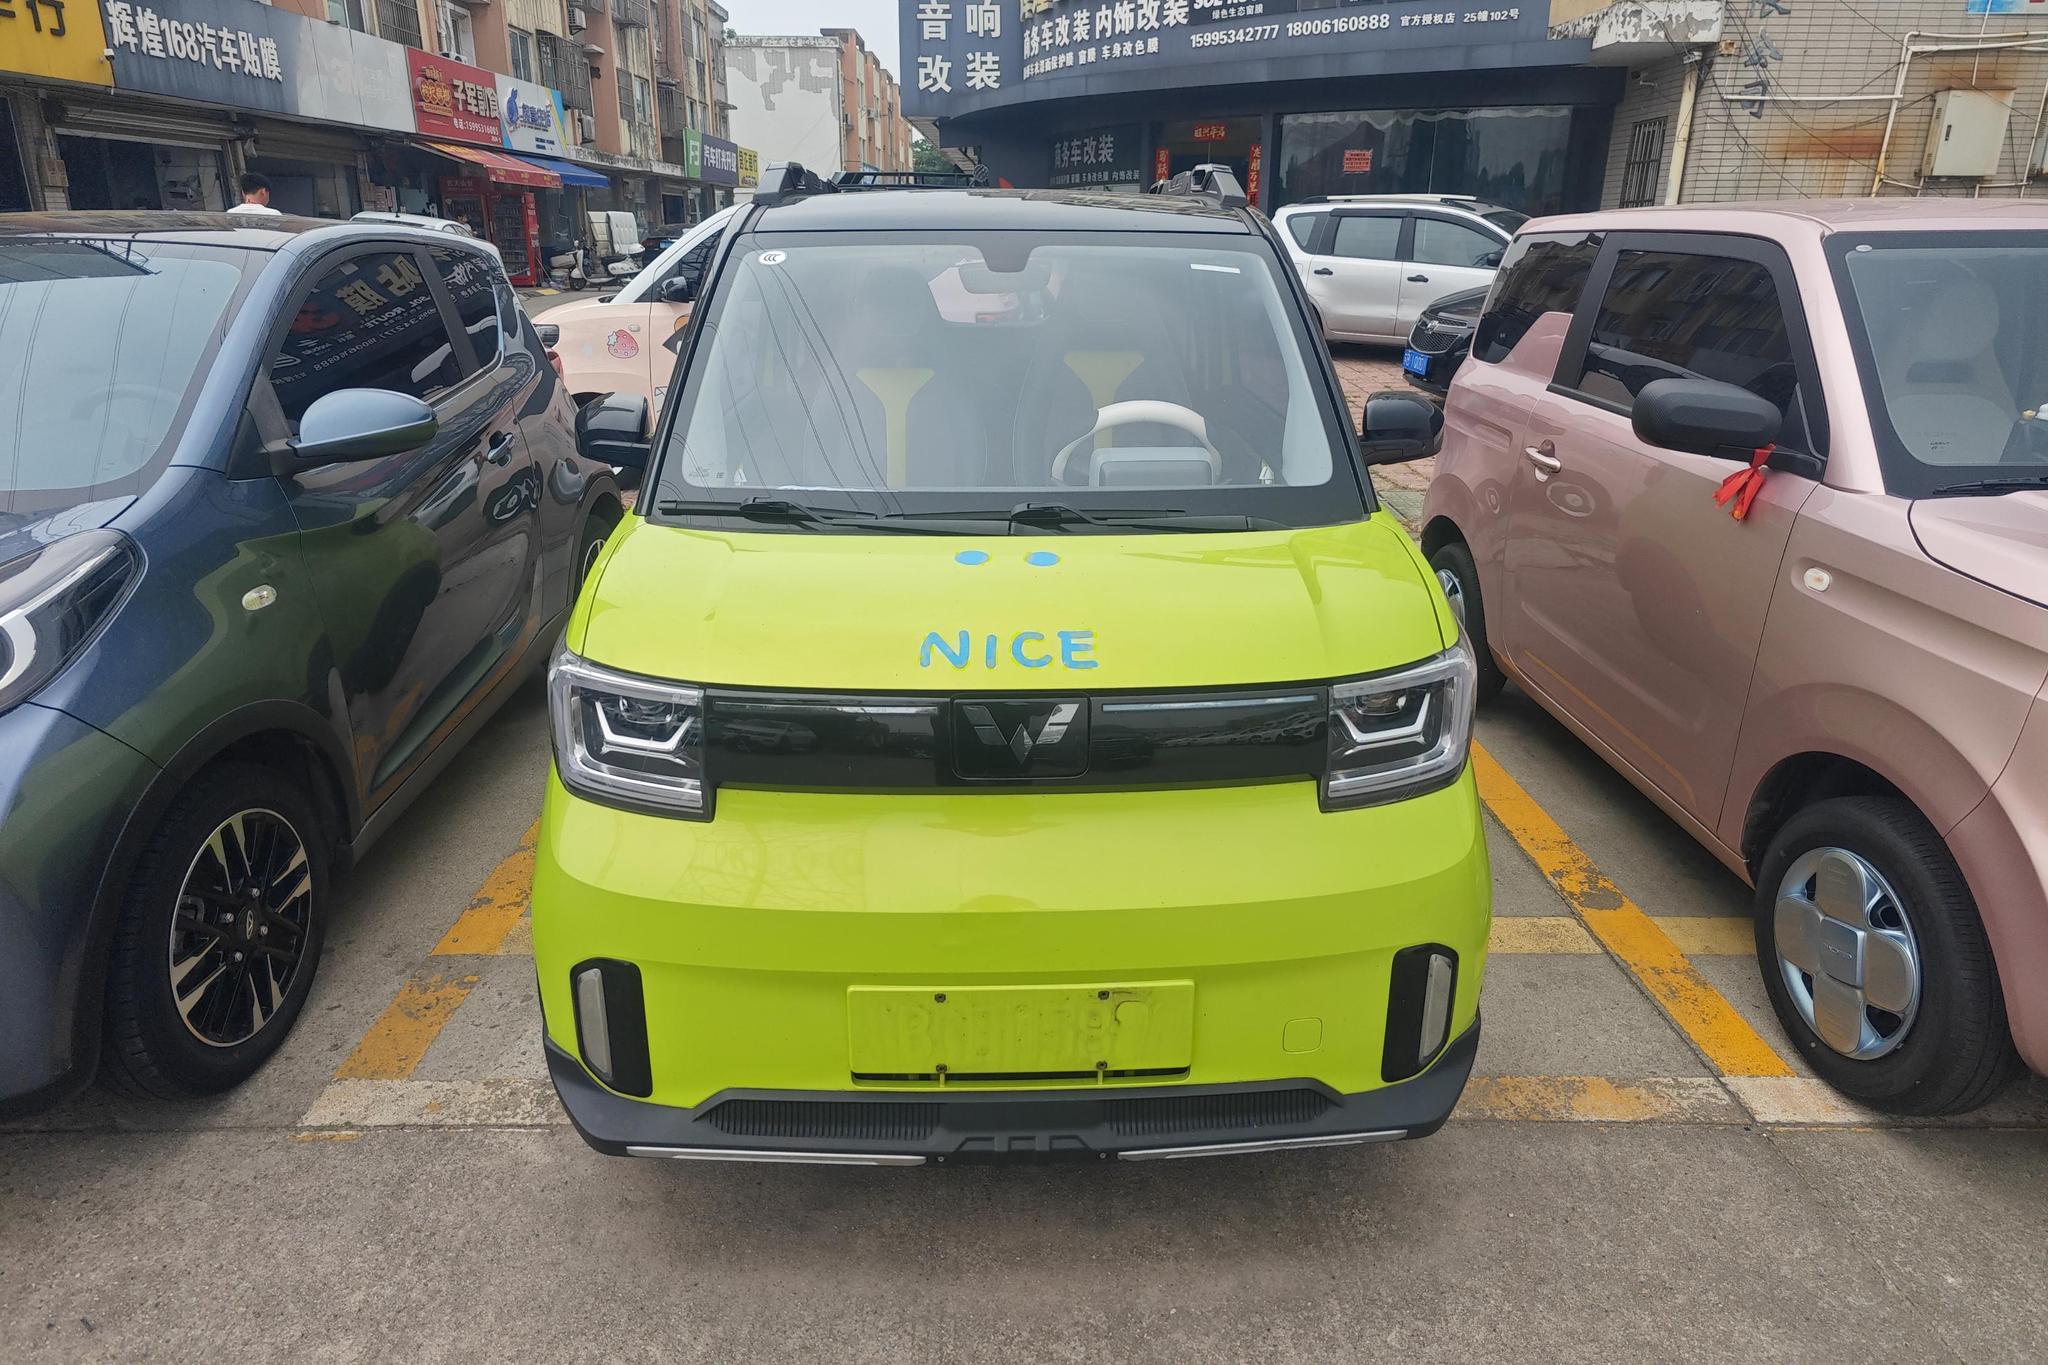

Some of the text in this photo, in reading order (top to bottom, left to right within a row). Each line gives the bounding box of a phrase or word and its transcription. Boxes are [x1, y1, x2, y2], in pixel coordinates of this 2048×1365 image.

[0, 0, 65, 36] 行
[917, 0, 1000, 40] 音响
[1023, 8, 1091, 59] 商务车改装
[1095, 0, 1190, 39] 内饰改装
[1190, 24, 1280, 48] 15995342777
[1286, 13, 1390, 37] 18006160888
[1400, 12, 1456, 27] 官方授权店
[105, 0, 283, 82] 辉煌168汽车贴膜
[1101, 37, 1159, 60] 车身改色膜
[917, 52, 1001, 93] 改装
[452, 78, 500, 119] 子军副食
[919, 630, 1099, 669] NICE
